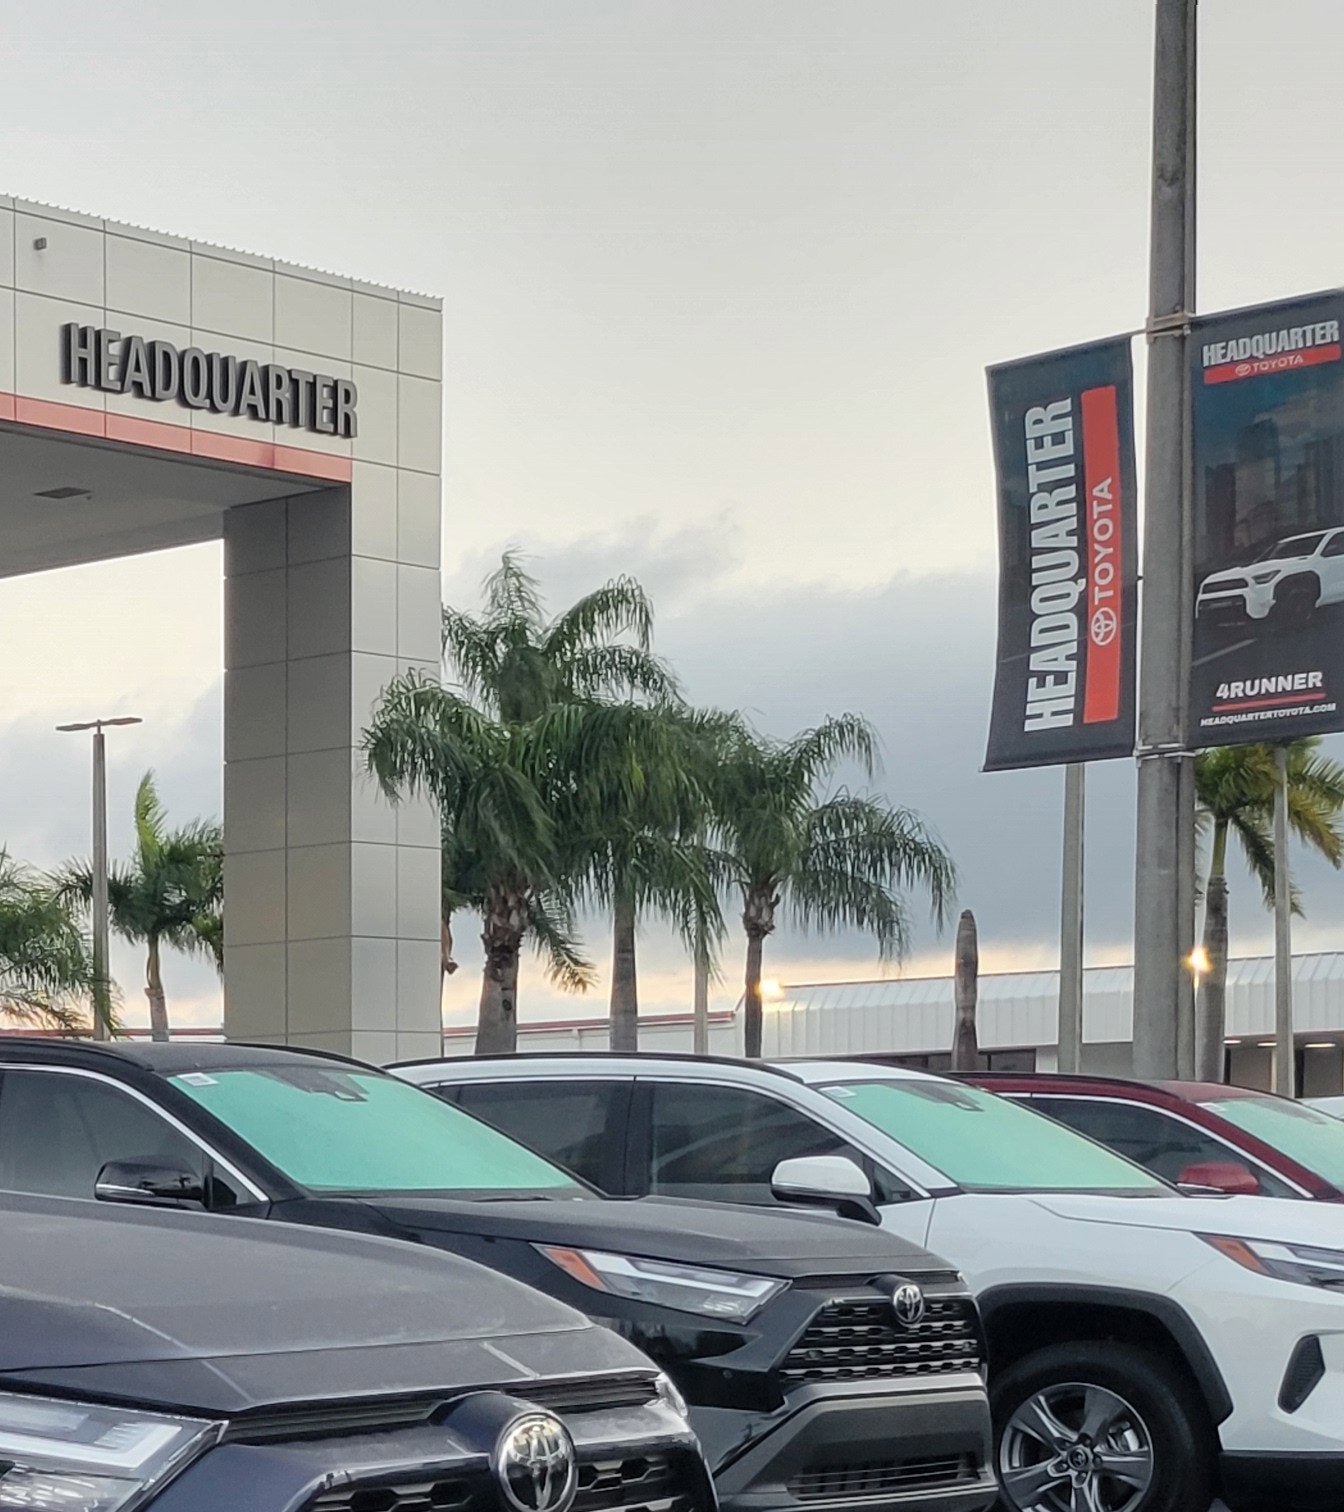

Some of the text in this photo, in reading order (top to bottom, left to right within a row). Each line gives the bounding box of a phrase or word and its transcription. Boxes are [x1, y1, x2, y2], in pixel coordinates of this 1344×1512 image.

[60, 322, 359, 438] HEADQUARTER
[1203, 320, 1340, 368] HEADQUARTER
[1252, 355, 1304, 372] TOYOTA
[1024, 397, 1087, 732] HEADQUARTER
[1092, 477, 1115, 602] TOYOTA
[1216, 671, 1323, 699] 4RUNNER
